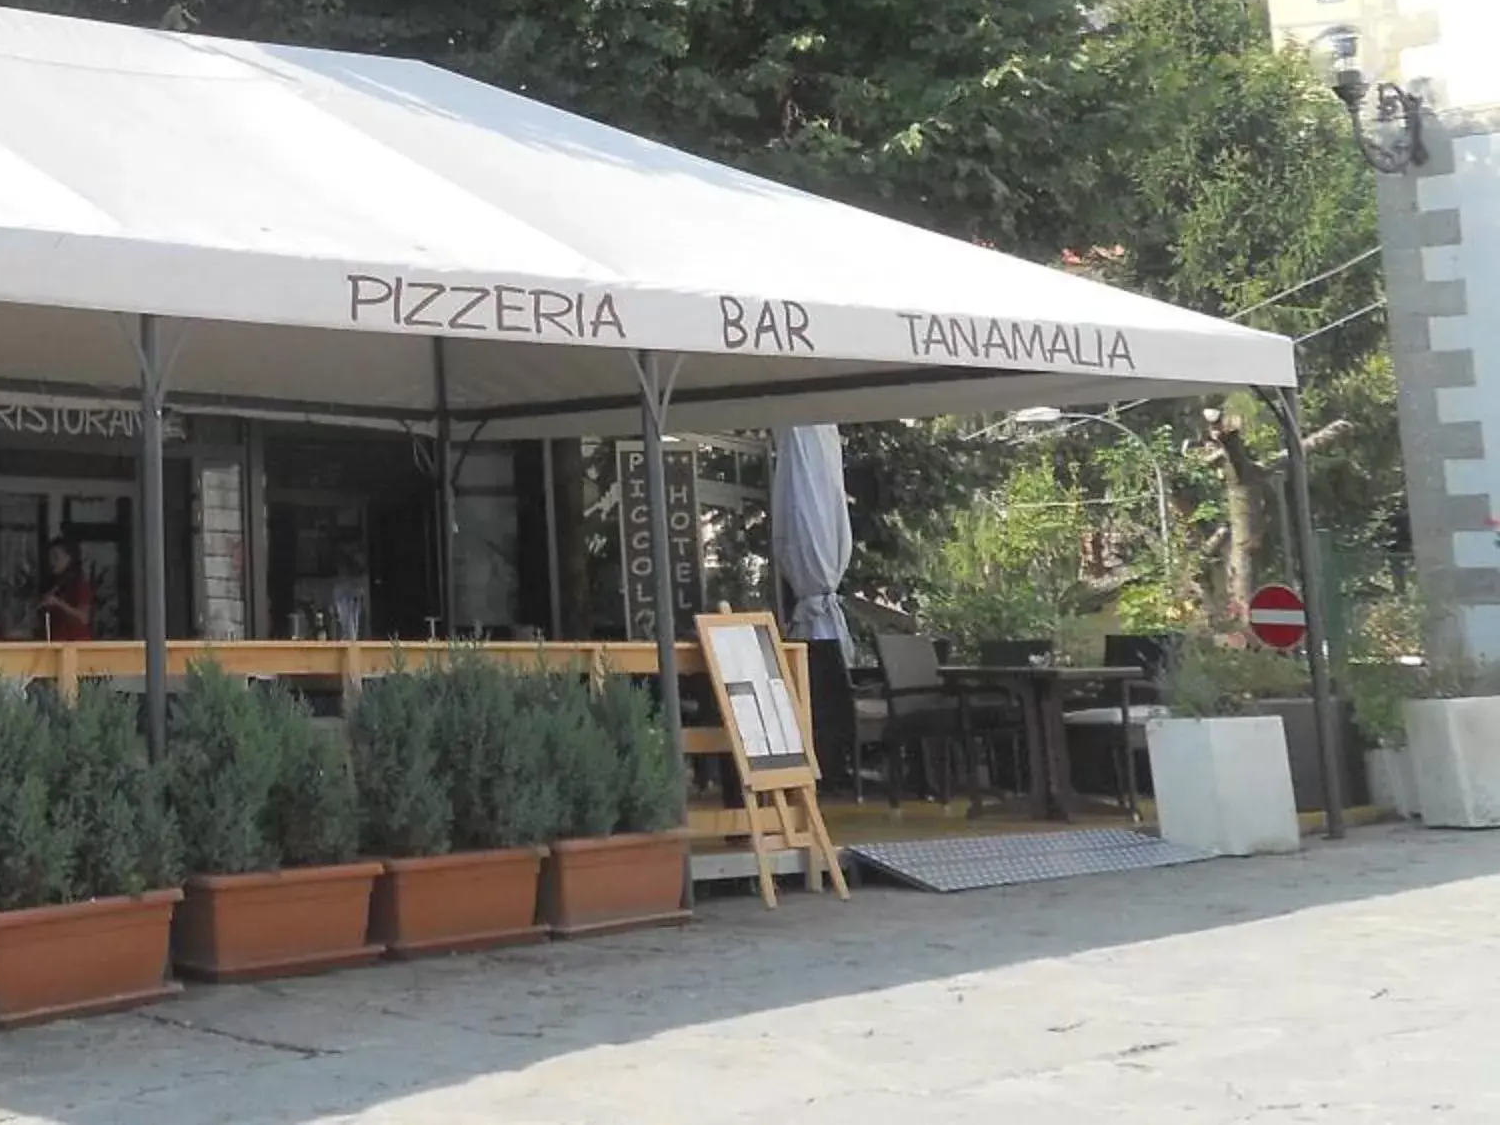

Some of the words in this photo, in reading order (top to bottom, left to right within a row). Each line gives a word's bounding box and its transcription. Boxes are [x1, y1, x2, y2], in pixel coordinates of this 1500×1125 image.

[346, 274, 628, 340] PIZZERIA
[719, 295, 816, 353] BAR
[897, 312, 1138, 371] TANAMALIA
[629, 452, 655, 635] PICCOLO
[669, 484, 692, 609] HOTEL
